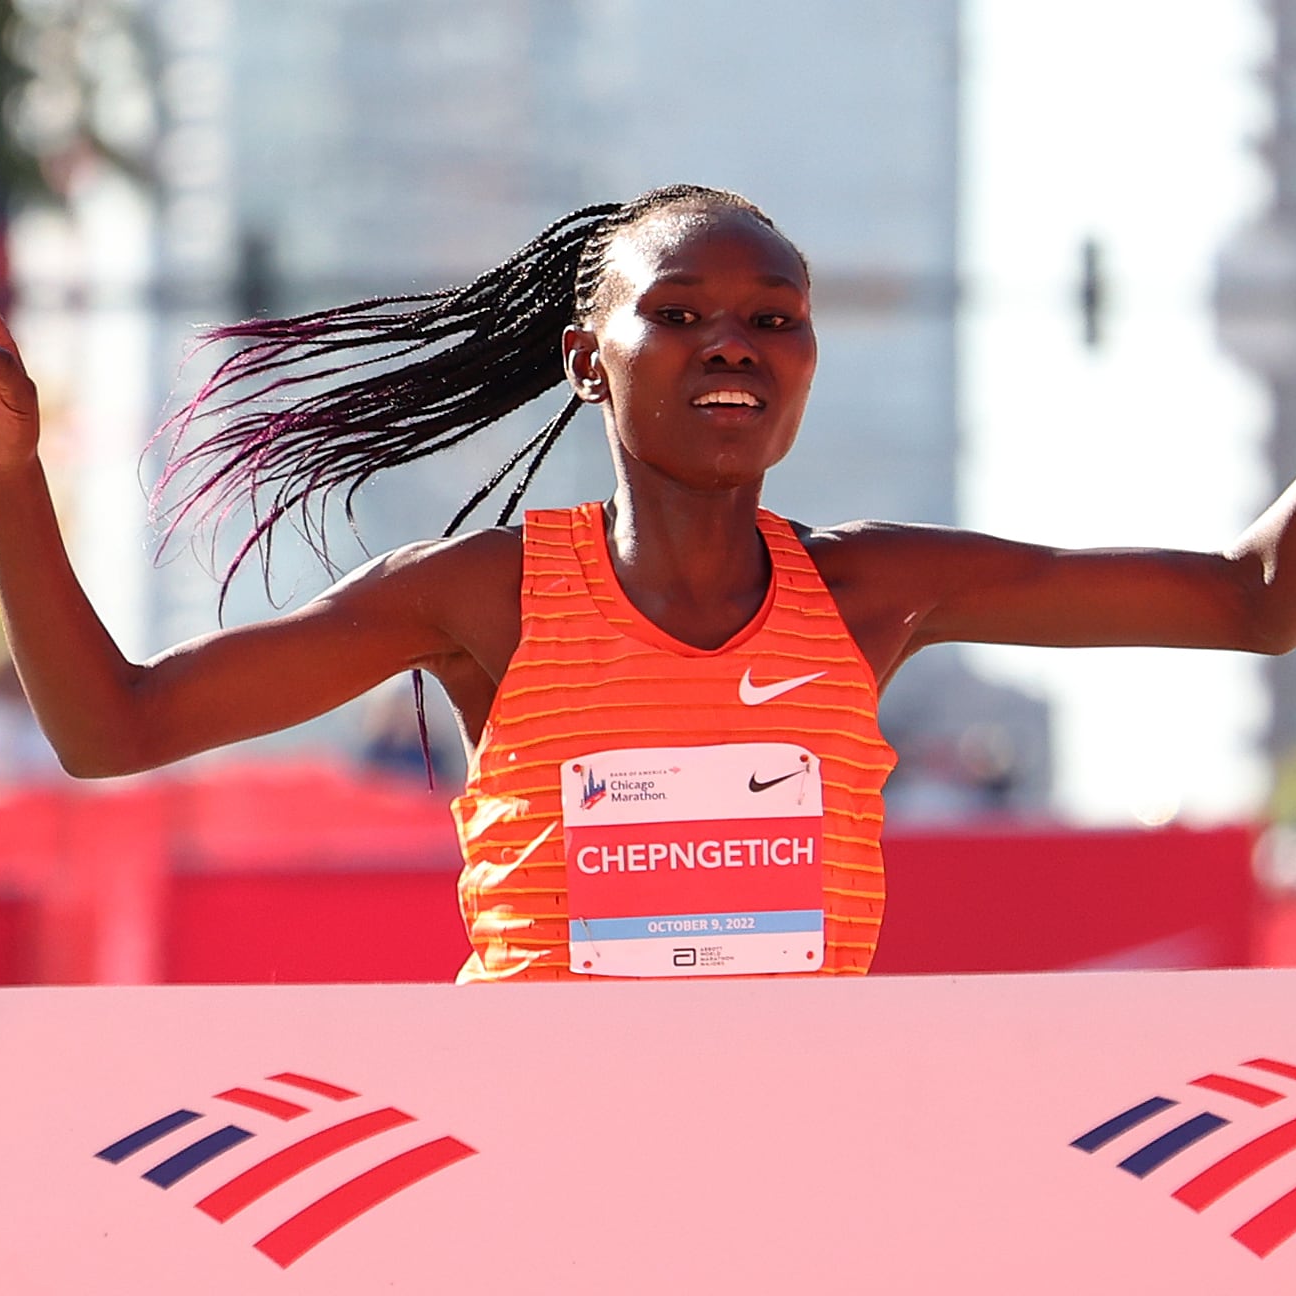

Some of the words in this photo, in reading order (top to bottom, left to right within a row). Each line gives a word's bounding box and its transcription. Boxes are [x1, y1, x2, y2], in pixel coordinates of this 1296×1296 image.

[610, 780, 655, 792] Chicago
[611, 791, 666, 802] Marathon
[576, 836, 815, 875] CHEPNGETICH
[647, 919, 708, 933] OCTOBER
[711, 918, 723, 931] 9,
[726, 917, 756, 930] 2022
